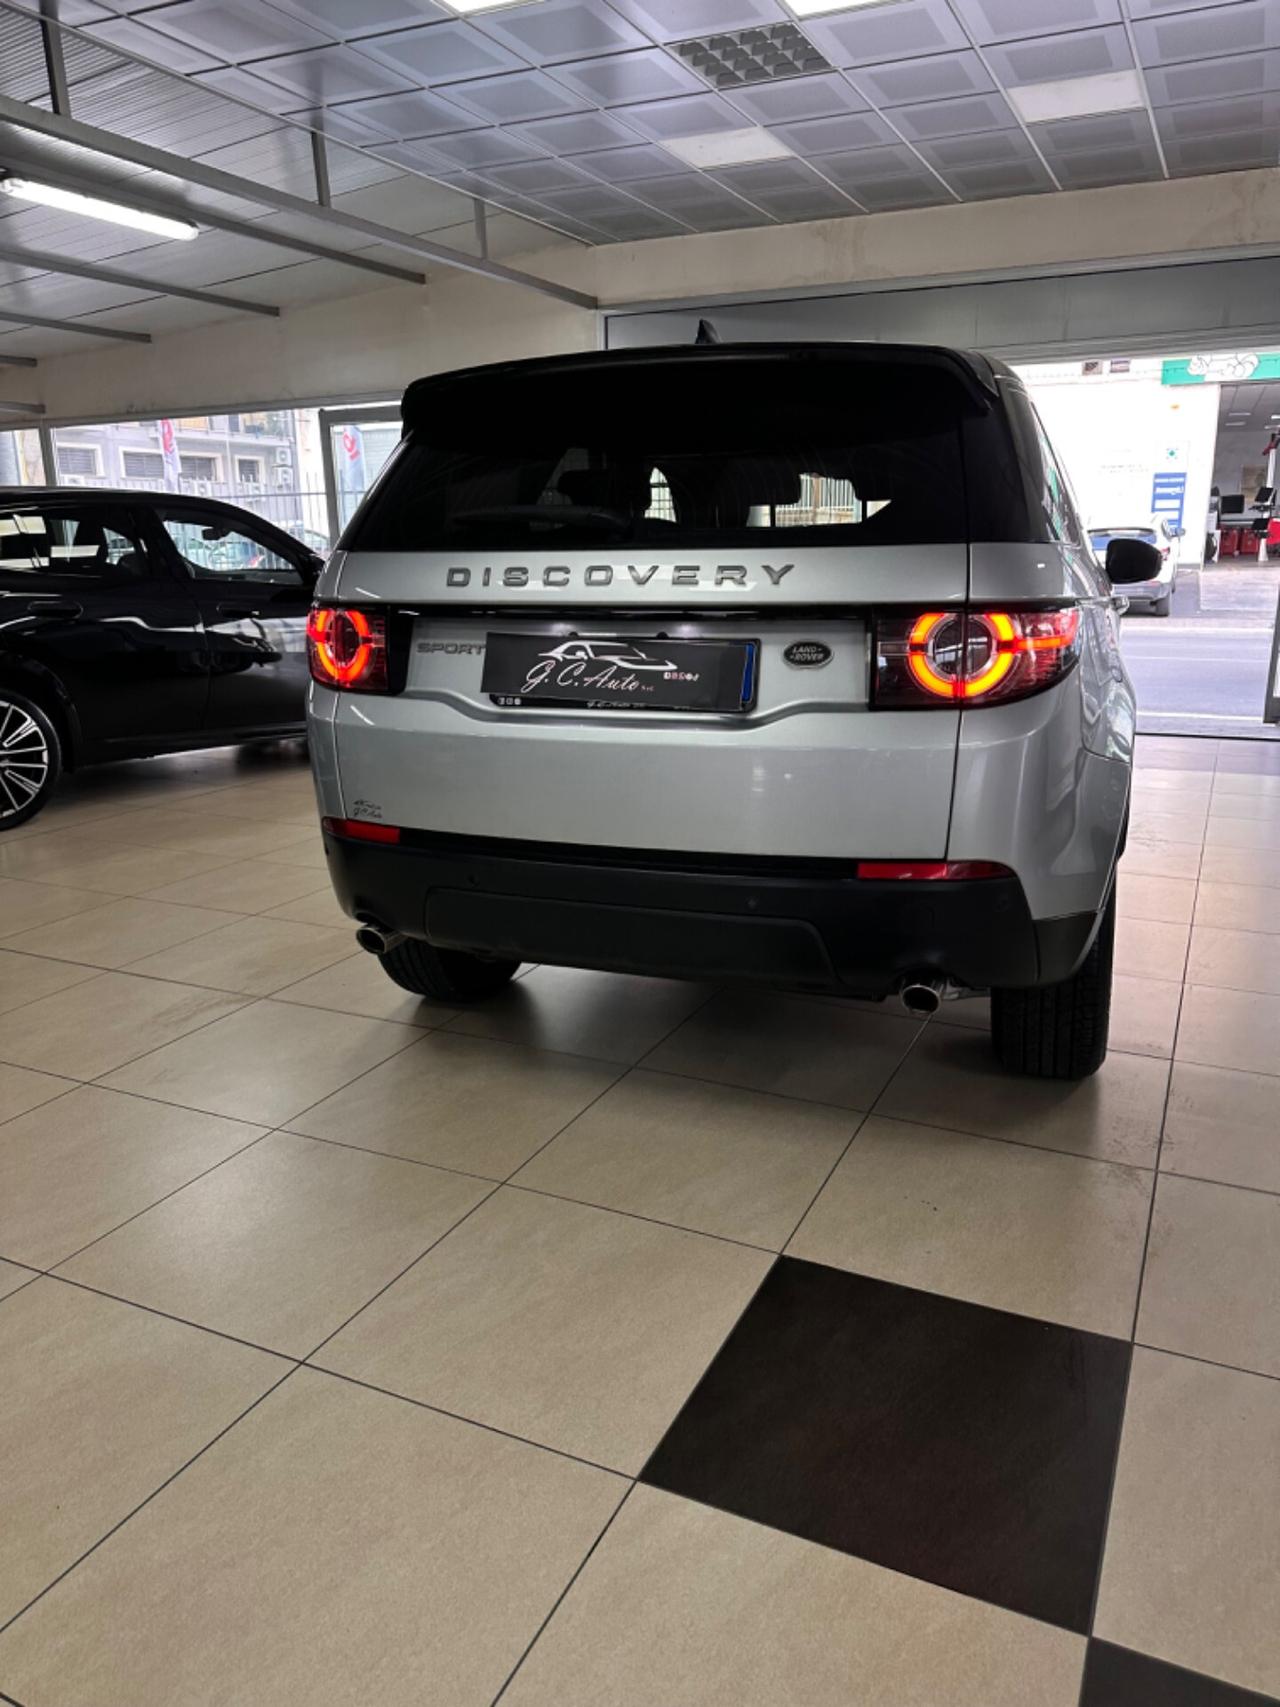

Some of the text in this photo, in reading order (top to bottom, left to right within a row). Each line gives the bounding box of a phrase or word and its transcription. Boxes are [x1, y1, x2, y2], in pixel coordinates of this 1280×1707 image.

[445, 564, 795, 588] DISCOVERY
[416, 642, 486, 655] SPORT
[583, 664, 640, 691] Auto
